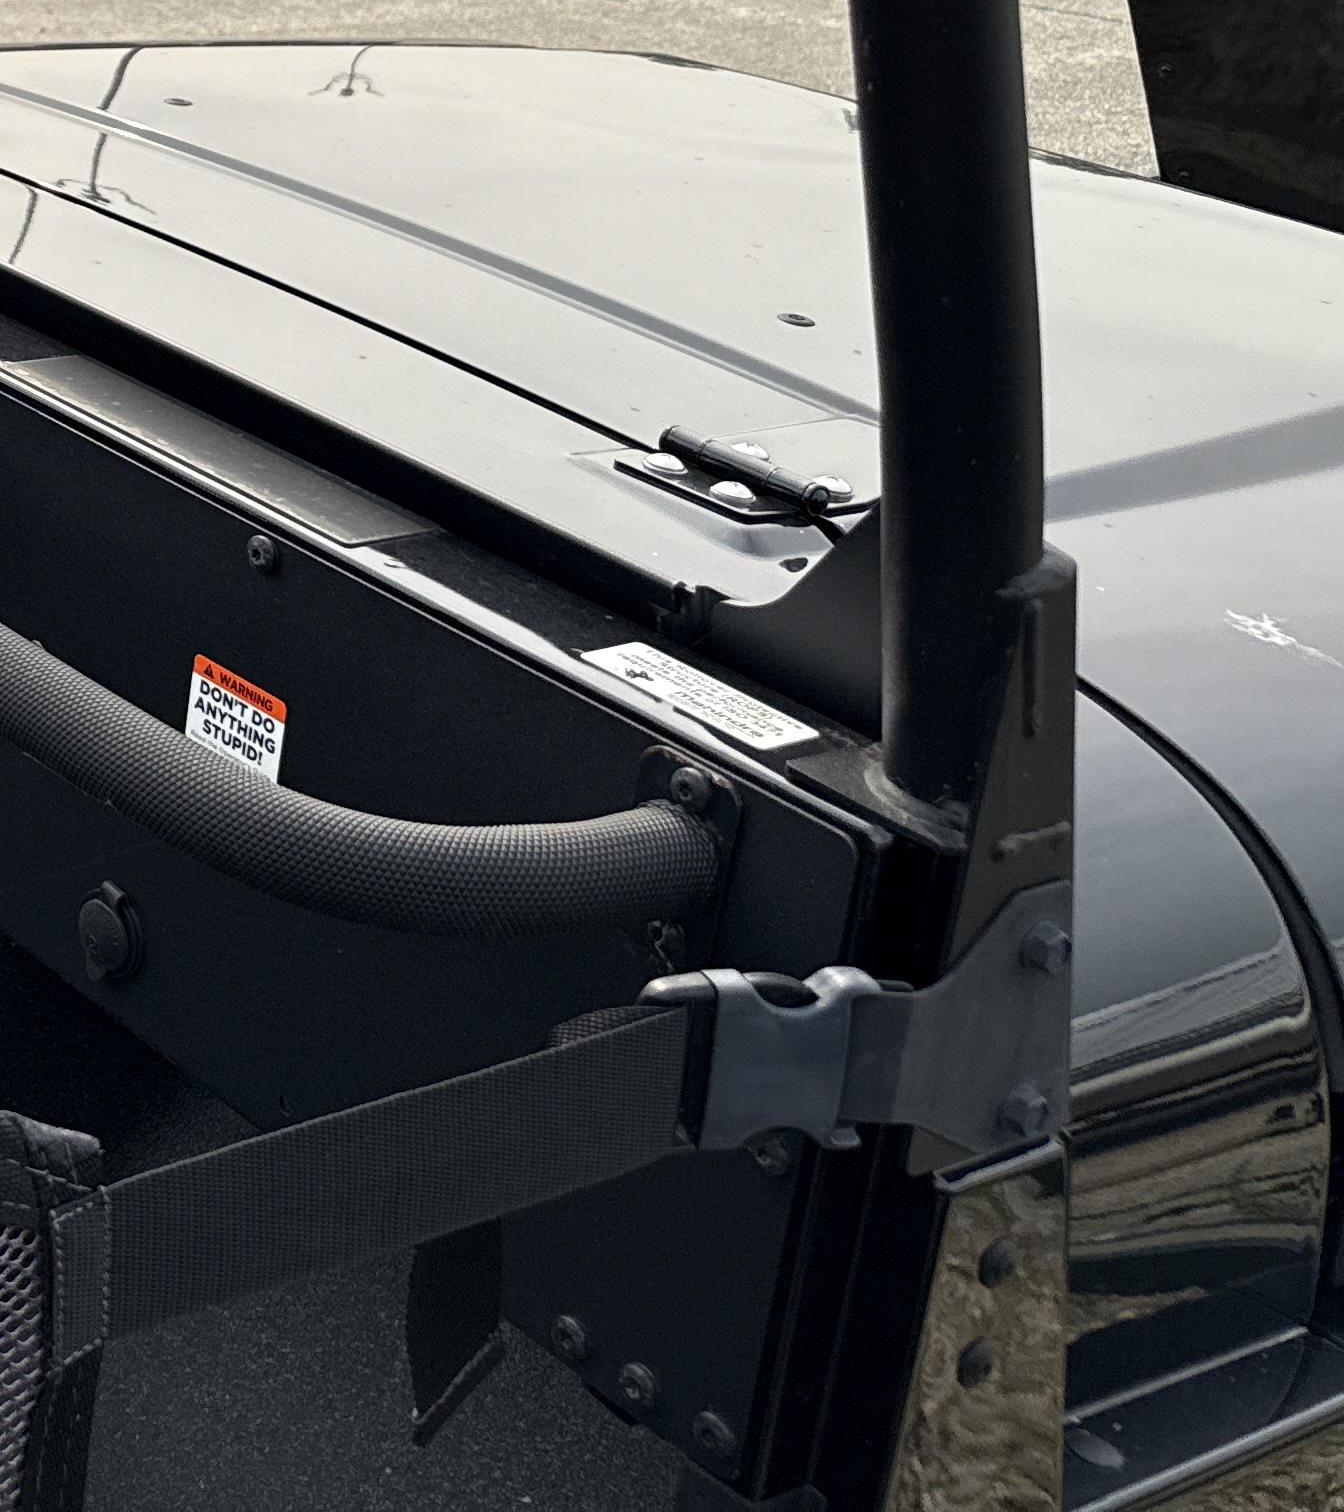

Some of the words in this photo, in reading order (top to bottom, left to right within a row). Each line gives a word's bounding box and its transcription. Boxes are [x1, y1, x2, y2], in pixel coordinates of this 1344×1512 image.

[199, 679, 248, 718] DON'T
[251, 709, 275, 734] DO
[219, 672, 274, 712] WARNING
[194, 696, 276, 754] ANYTHING
[202, 718, 264, 767] STUPID!
